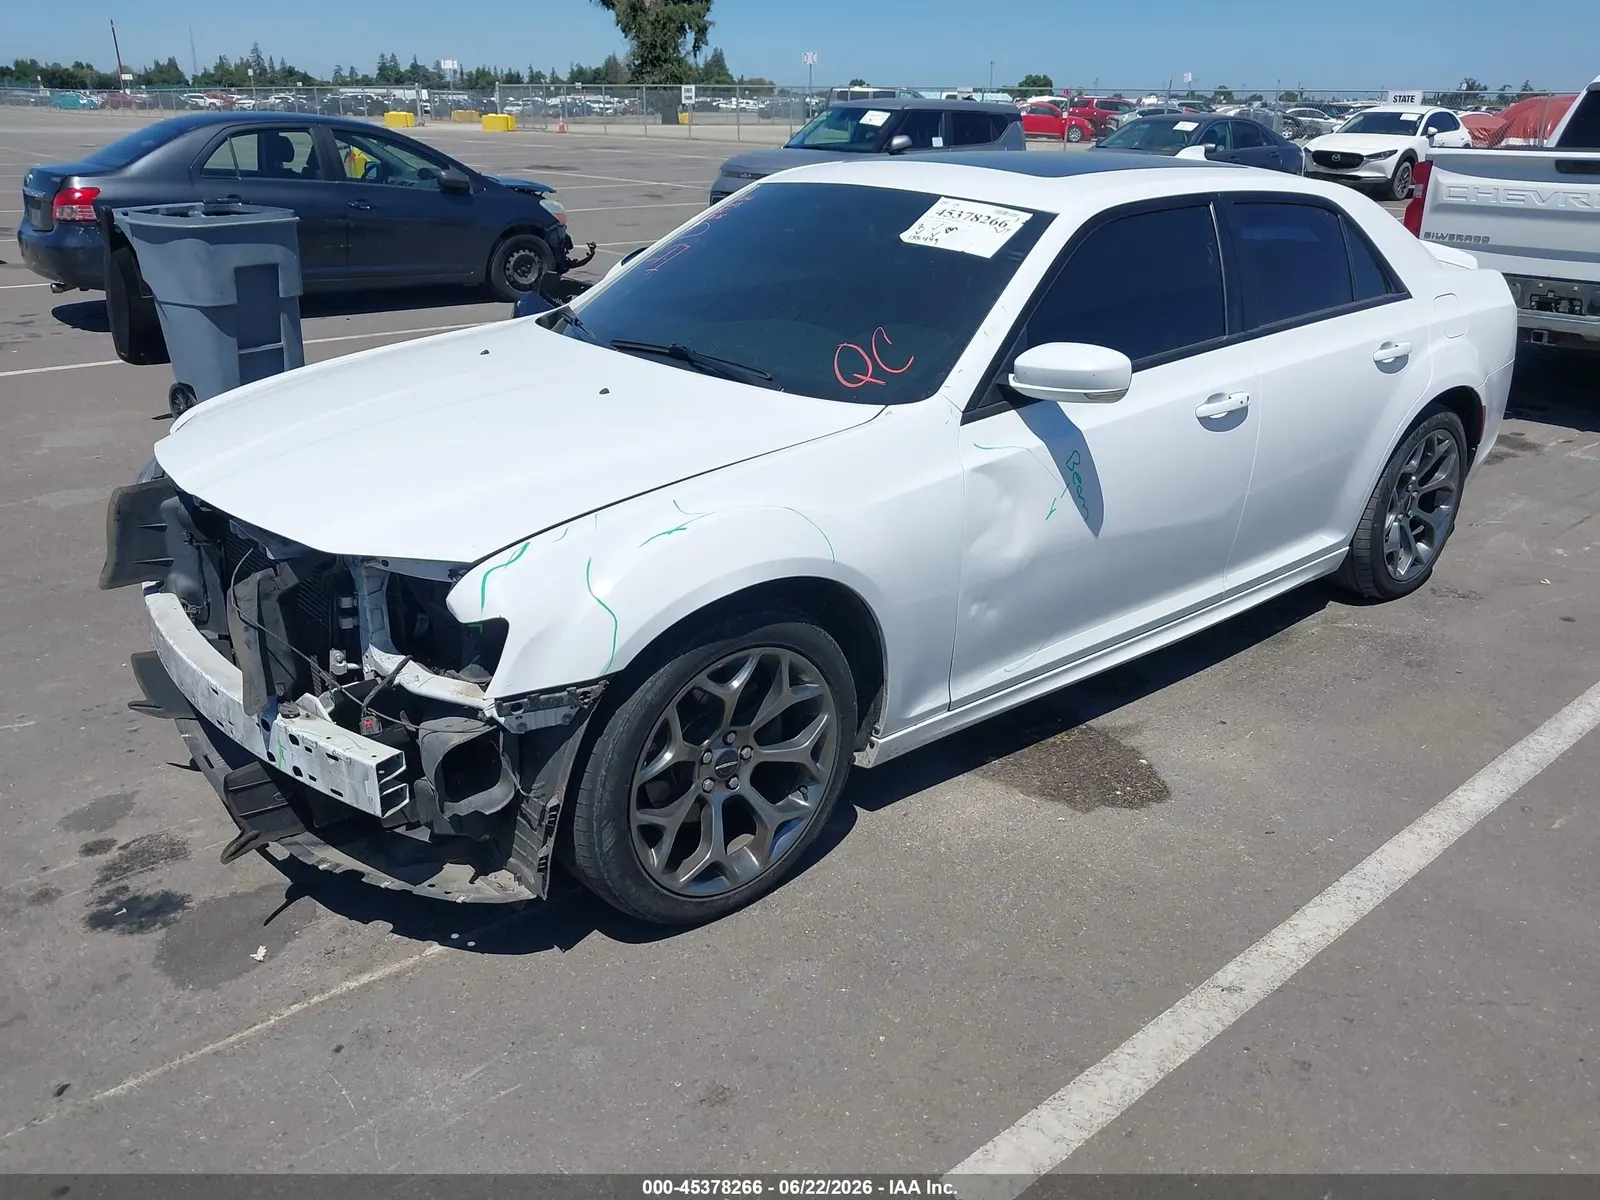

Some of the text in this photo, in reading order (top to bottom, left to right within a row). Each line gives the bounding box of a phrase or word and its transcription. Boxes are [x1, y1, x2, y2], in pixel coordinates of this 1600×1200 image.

[1392, 94, 1416, 103] STATE
[1443, 185, 1600, 208] CHEVR
[936, 208, 1008, 229] 45378266
[1423, 231, 1491, 244] SILVERADO
[833, 326, 915, 388] QC
